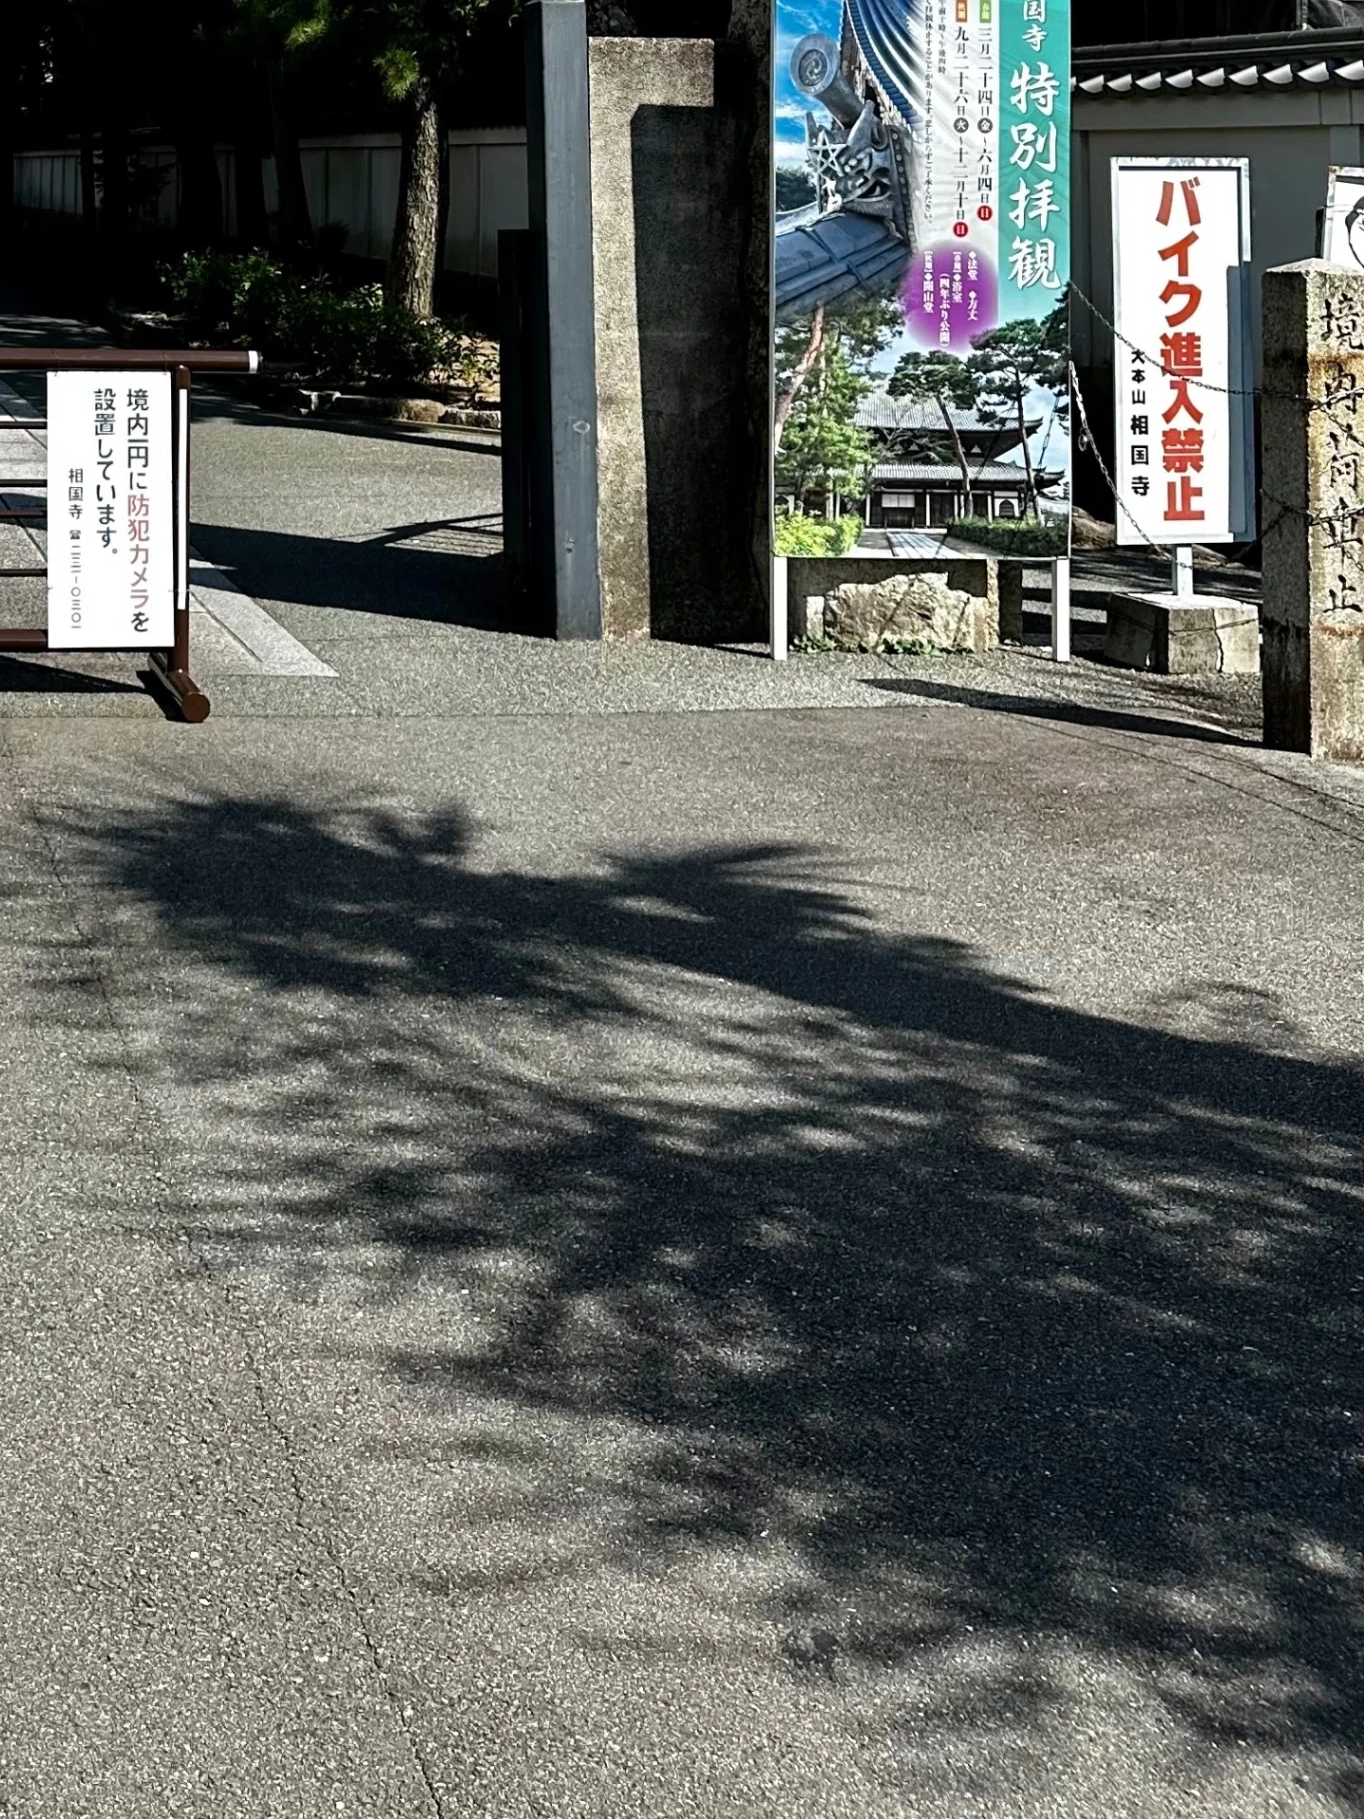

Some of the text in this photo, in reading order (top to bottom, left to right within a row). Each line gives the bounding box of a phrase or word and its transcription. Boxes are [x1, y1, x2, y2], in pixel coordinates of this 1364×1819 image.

[1009, 61, 1063, 290] 特別拝観
[1155, 176, 1205, 521] バイク進入禁止
[68, 467, 84, 520] 相国寺
[93, 388, 118, 555] 設置しています。
[126, 388, 150, 633] 境内一円に防犯カメラを
